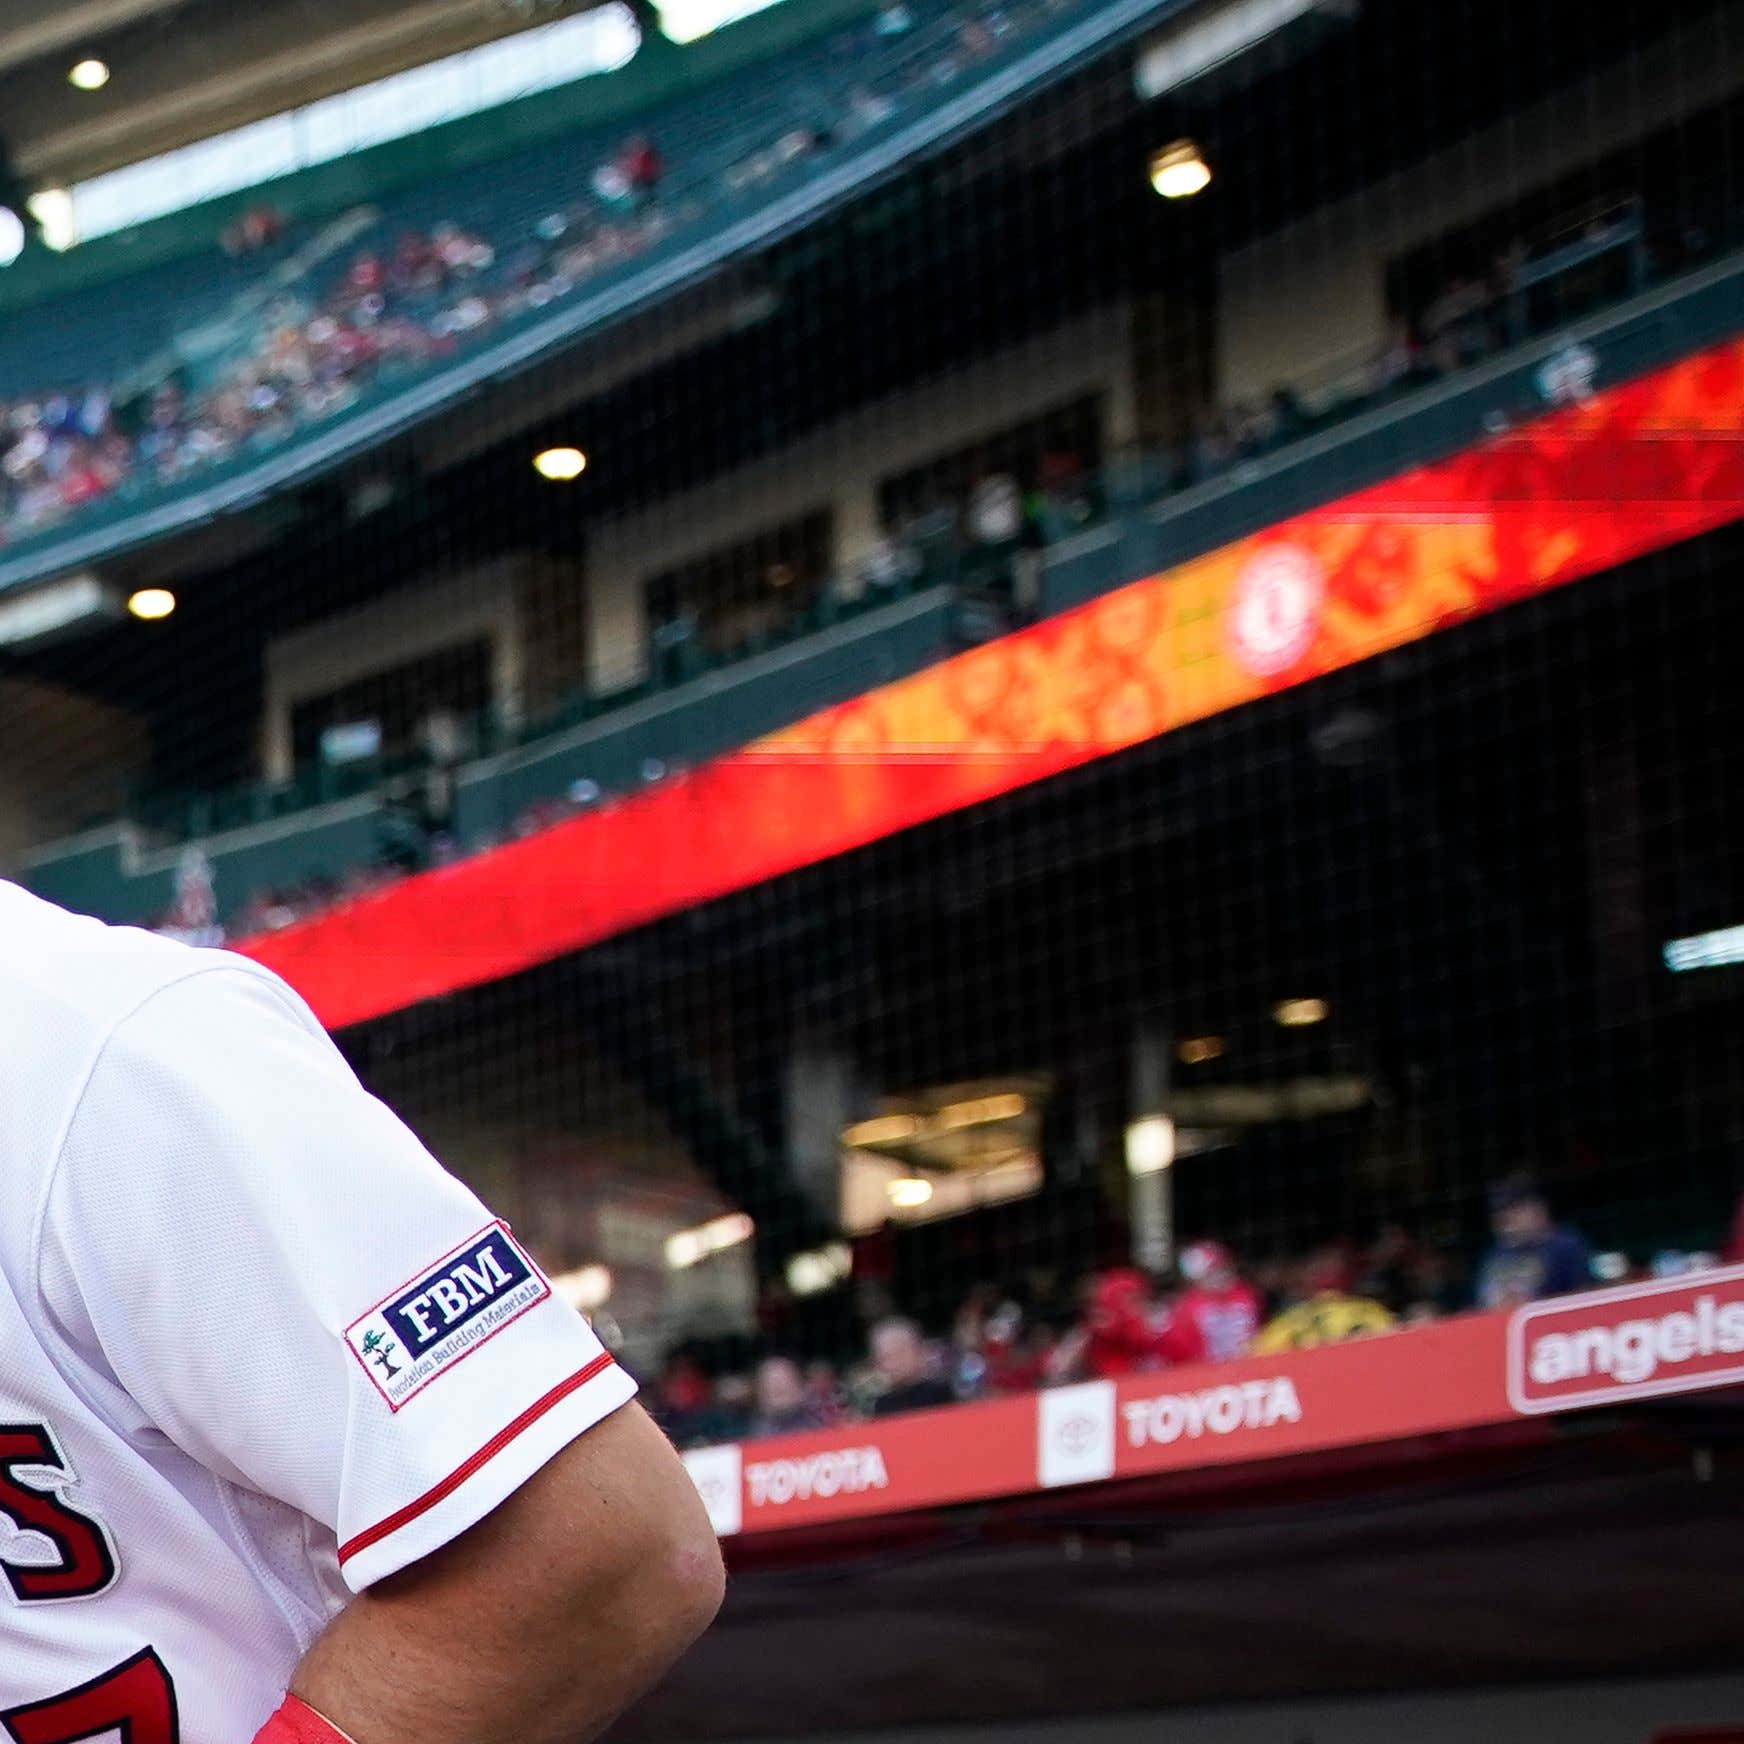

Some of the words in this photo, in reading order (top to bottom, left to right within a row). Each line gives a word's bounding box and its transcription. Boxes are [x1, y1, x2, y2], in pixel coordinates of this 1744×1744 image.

[399, 1246, 512, 1343] FBM
[1529, 1293, 1744, 1384] angels
[1124, 1377, 1301, 1447] TOYOTA
[747, 1446, 888, 1506] TOYOTA
